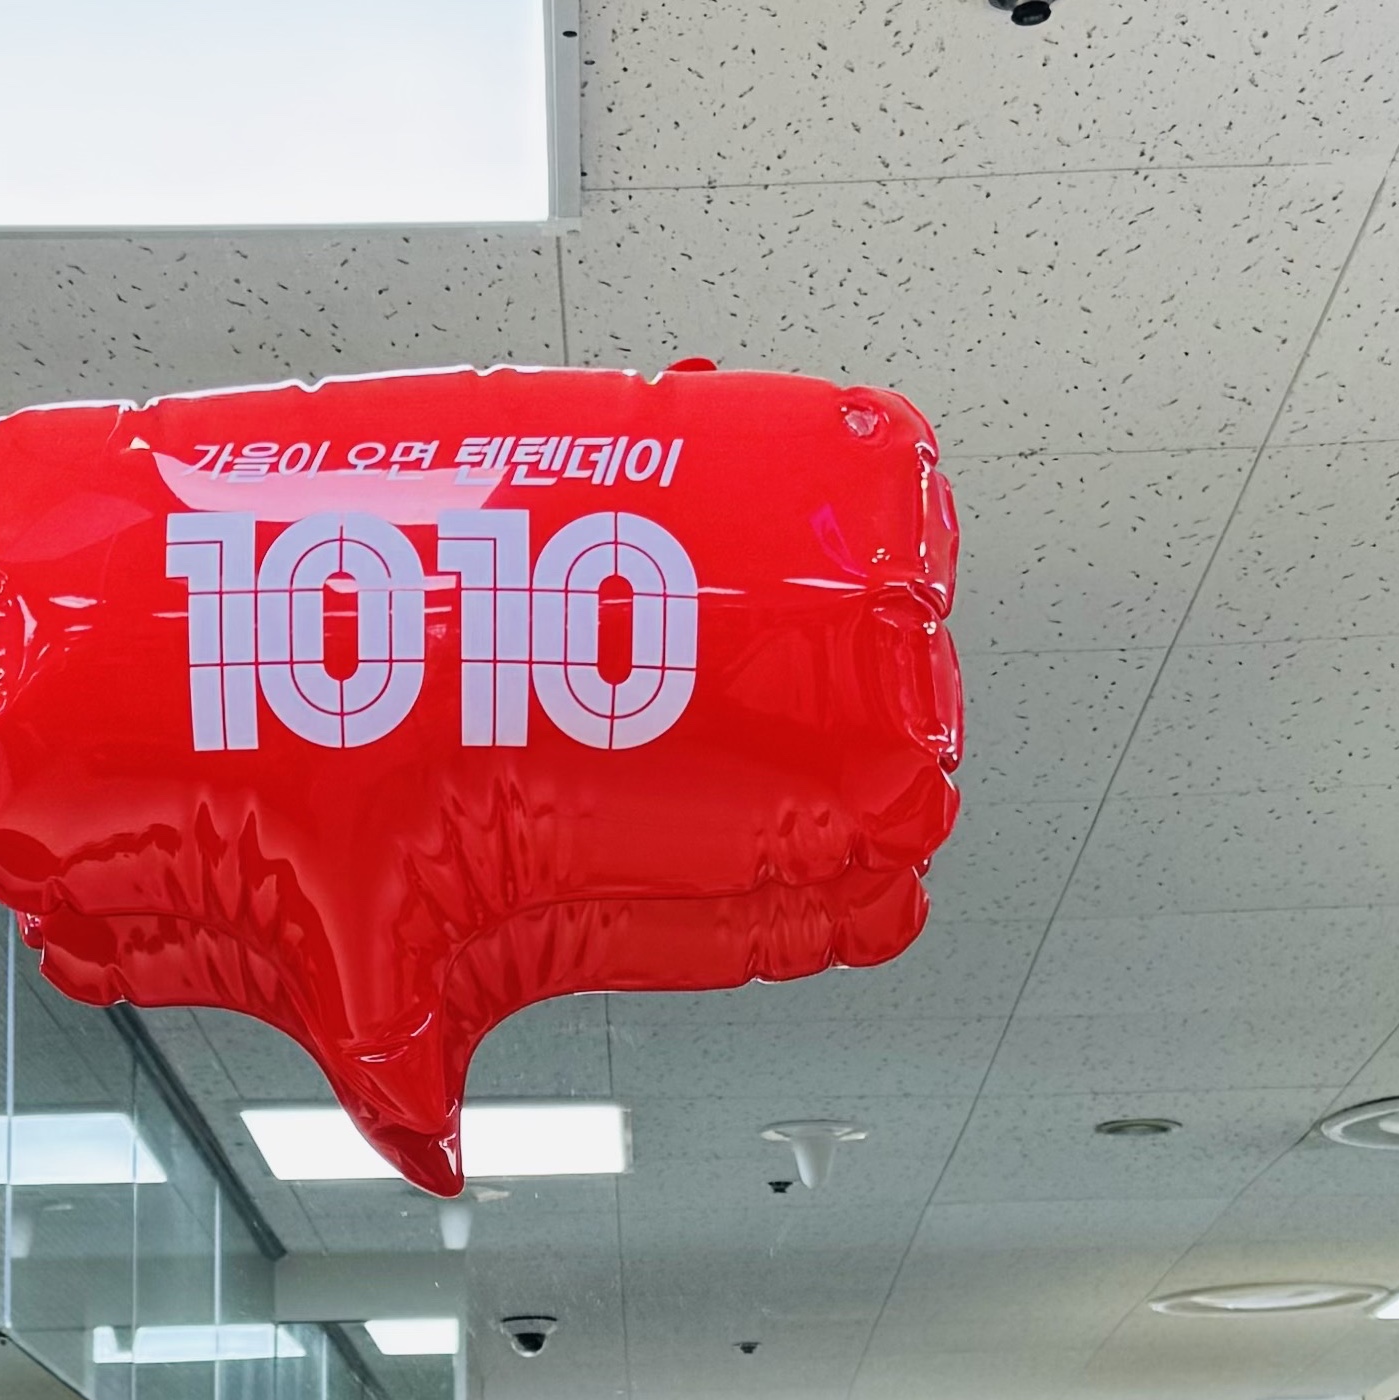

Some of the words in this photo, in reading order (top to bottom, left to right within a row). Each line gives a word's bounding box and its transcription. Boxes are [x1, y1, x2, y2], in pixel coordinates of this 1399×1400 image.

[181, 440, 330, 483] 가을이
[346, 440, 439, 481] 오면
[453, 436, 683, 487] 텐텐데이
